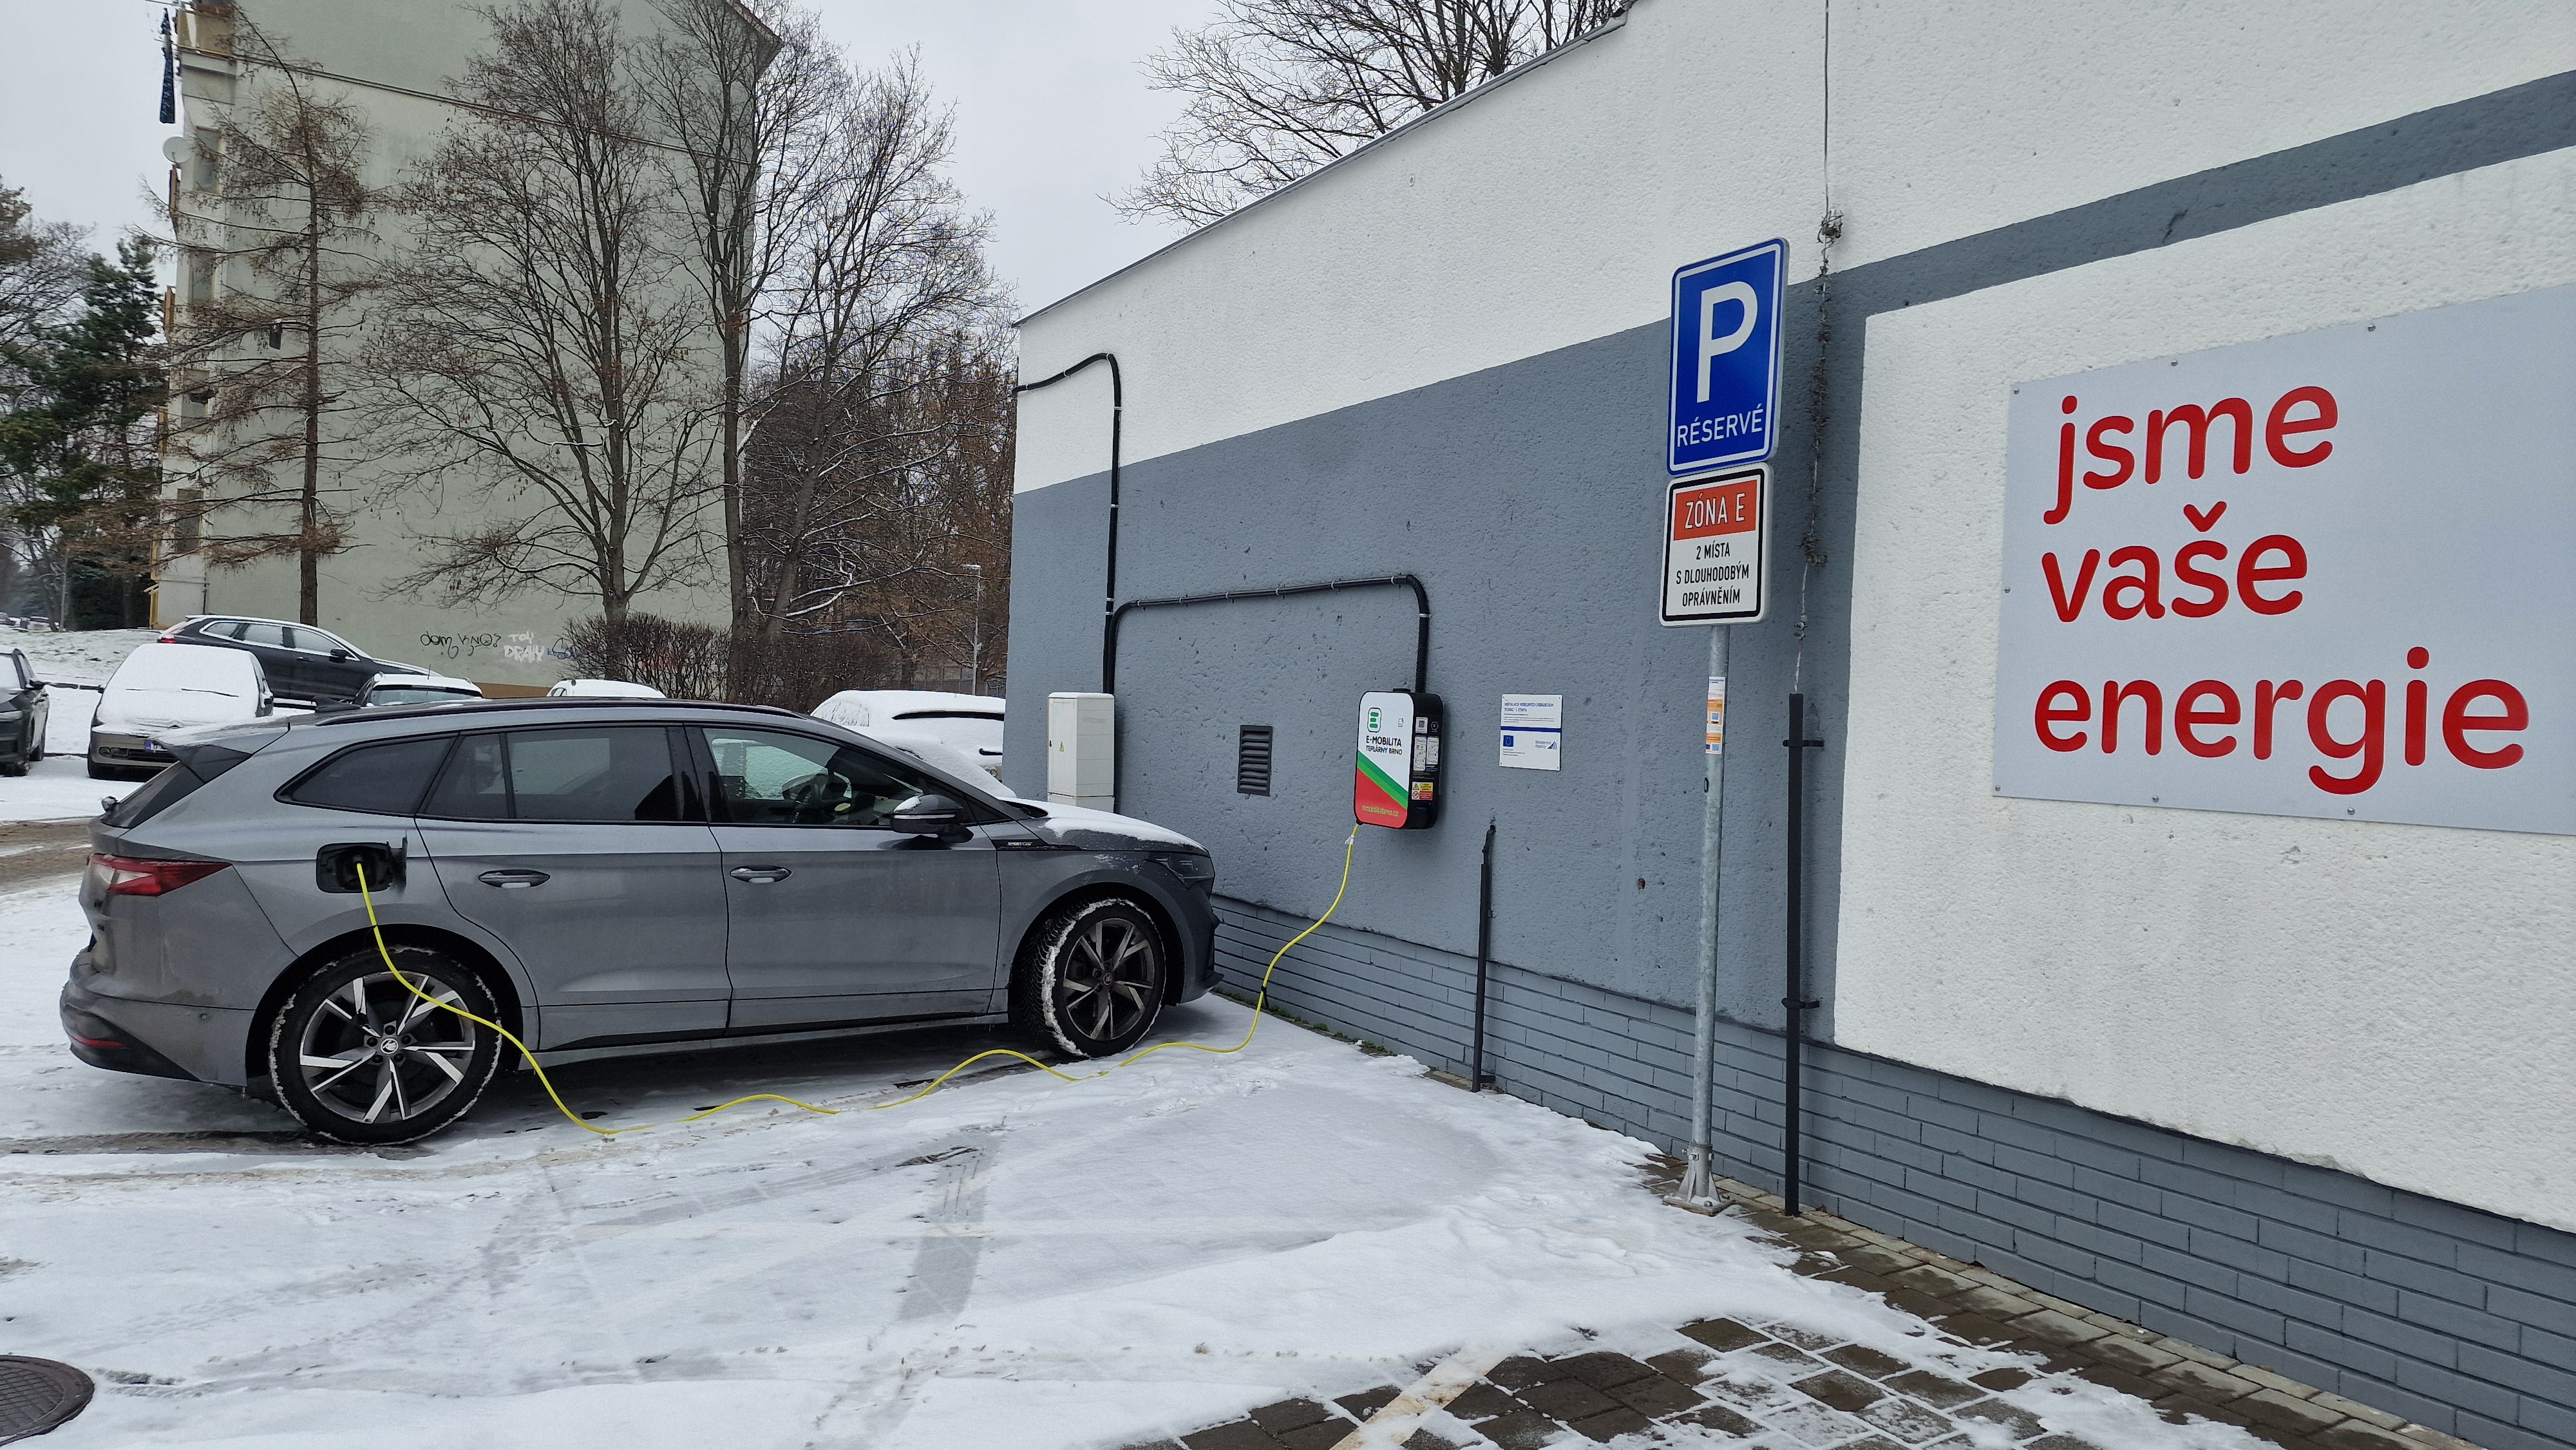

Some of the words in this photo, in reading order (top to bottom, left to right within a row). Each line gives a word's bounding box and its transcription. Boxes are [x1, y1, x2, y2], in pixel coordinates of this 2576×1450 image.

[1696, 281, 1758, 403] P
[1677, 403, 1764, 447] RÉSERVÉ
[2043, 386, 2338, 525] jsme
[1684, 493, 1728, 531] ZÓNA
[1736, 492, 1746, 523] E
[1696, 546, 1701, 560] 2
[1704, 540, 1730, 559] MÍSTA
[2041, 501, 2307, 623] vaše
[1676, 570, 1681, 585] S
[1684, 561, 1749, 584] DLOUHODOBÝM
[1682, 585, 1740, 607] OPRÁVNĚNÍM
[1366, 735, 1402, 747] E-MOBILITA
[2034, 646, 2530, 795] energie
